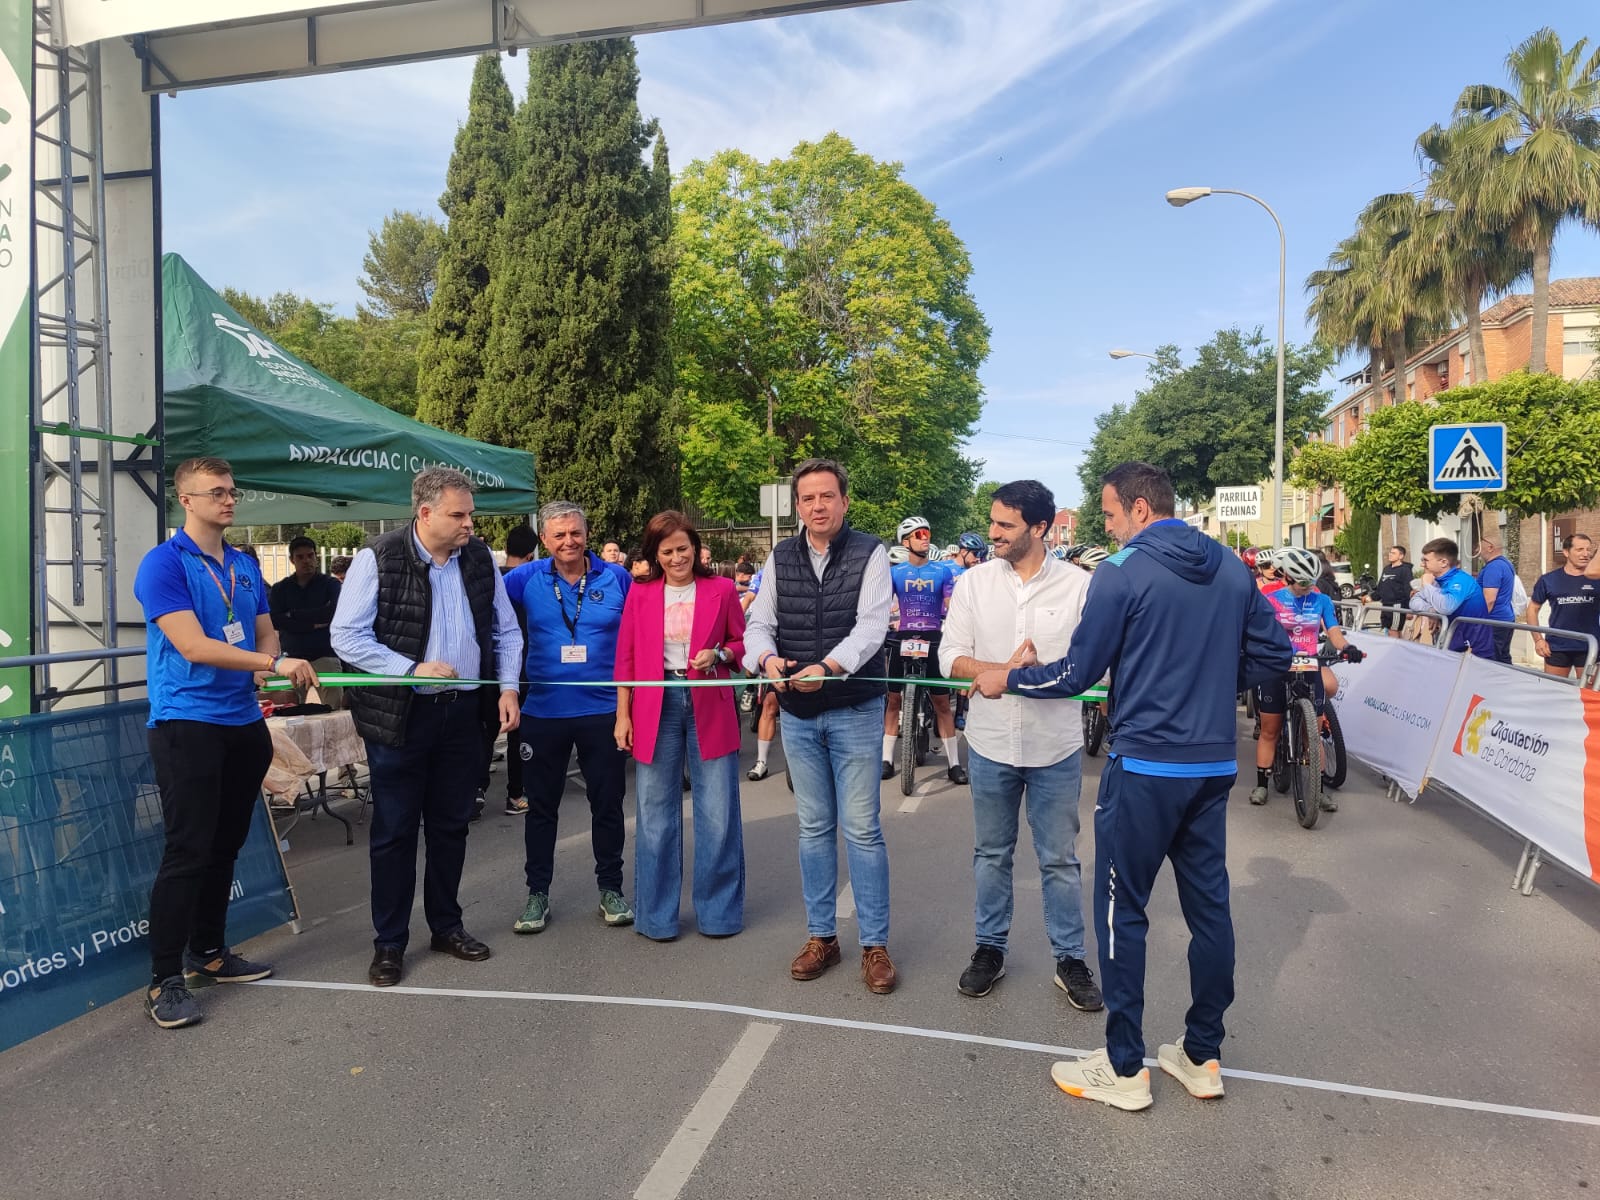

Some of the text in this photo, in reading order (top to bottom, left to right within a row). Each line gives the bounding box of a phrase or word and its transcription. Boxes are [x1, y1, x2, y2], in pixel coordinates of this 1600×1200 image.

[1219, 491, 1258, 503] PARRILLA
[907, 642, 922, 651] 31
[1490, 719, 1550, 757] Diputación
[1480, 743, 1537, 782] de Córdoba
[71, 942, 85, 967] y
